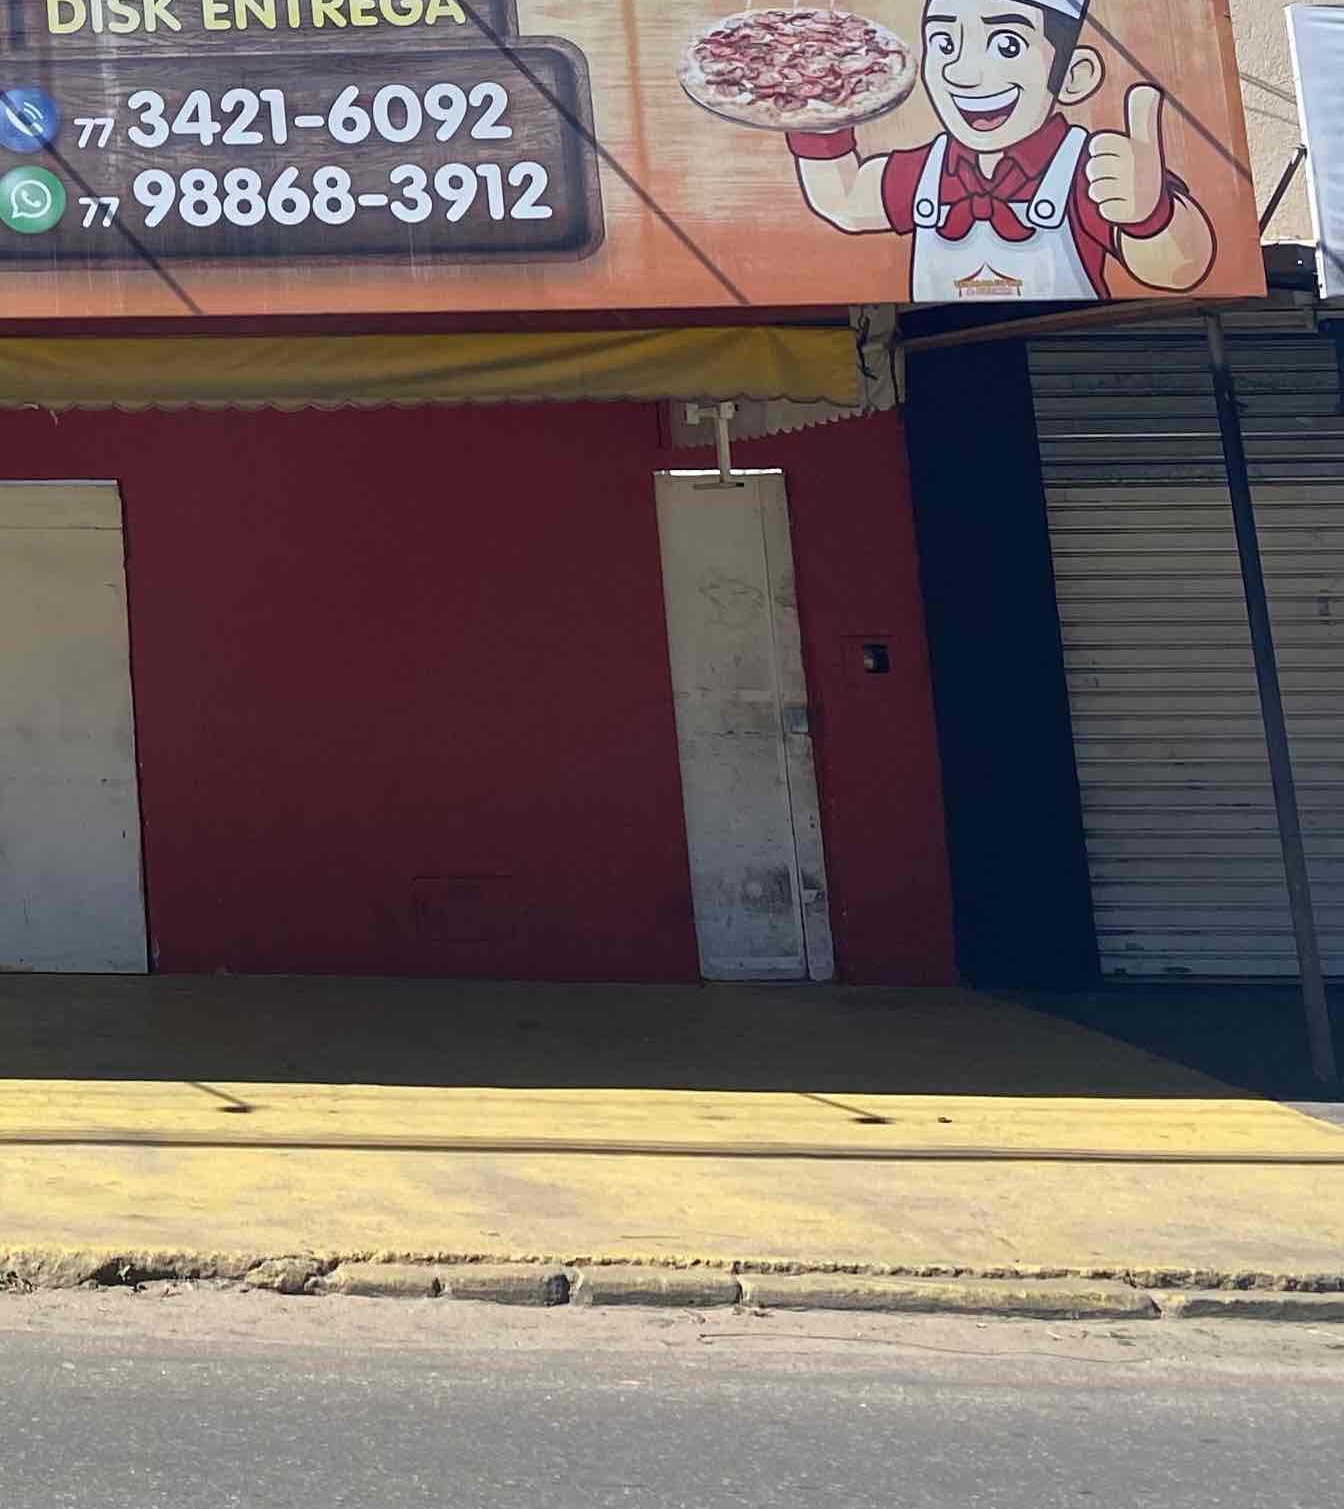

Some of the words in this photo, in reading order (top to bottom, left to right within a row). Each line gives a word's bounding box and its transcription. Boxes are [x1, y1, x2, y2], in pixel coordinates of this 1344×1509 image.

[74, 117, 114, 149] 77
[127, 81, 514, 148] 3421-6092
[78, 197, 117, 228] 77
[132, 161, 554, 229] 98868-3912
